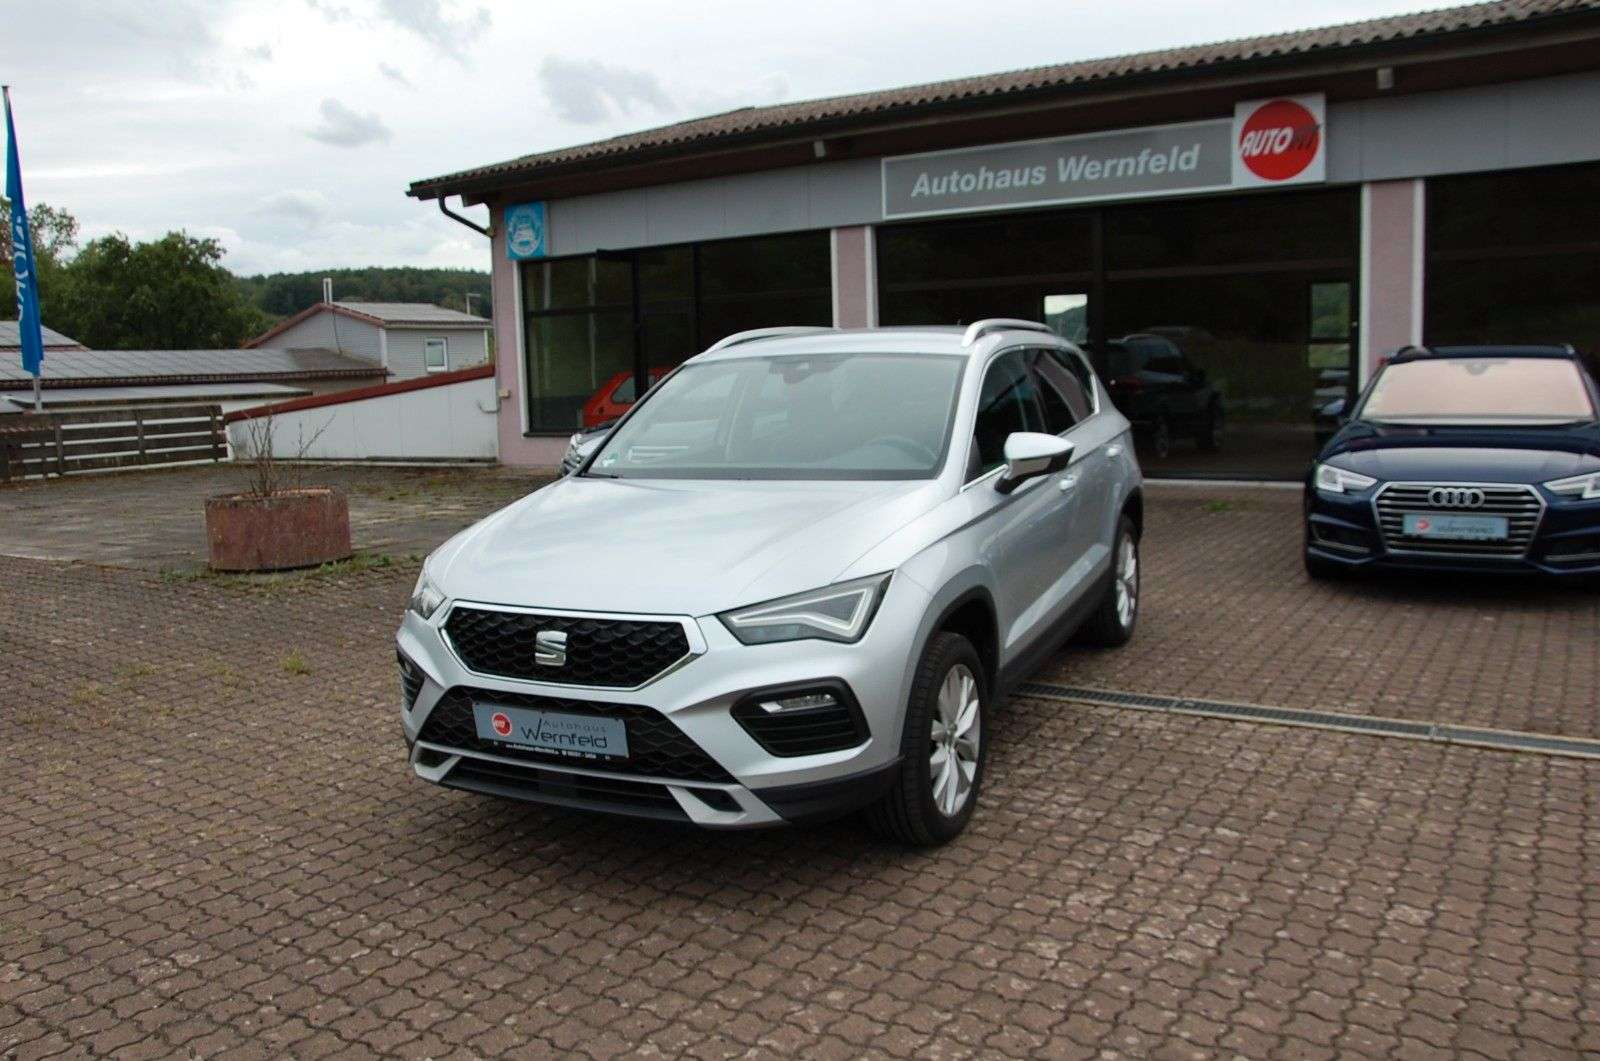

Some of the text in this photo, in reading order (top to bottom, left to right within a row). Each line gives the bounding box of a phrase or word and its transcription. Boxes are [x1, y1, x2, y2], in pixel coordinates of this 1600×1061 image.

[910, 143, 1201, 198] Autohaus Wernfeld
[521, 717, 608, 749] Wernfeld
[542, 719, 607, 733] Autohaus
